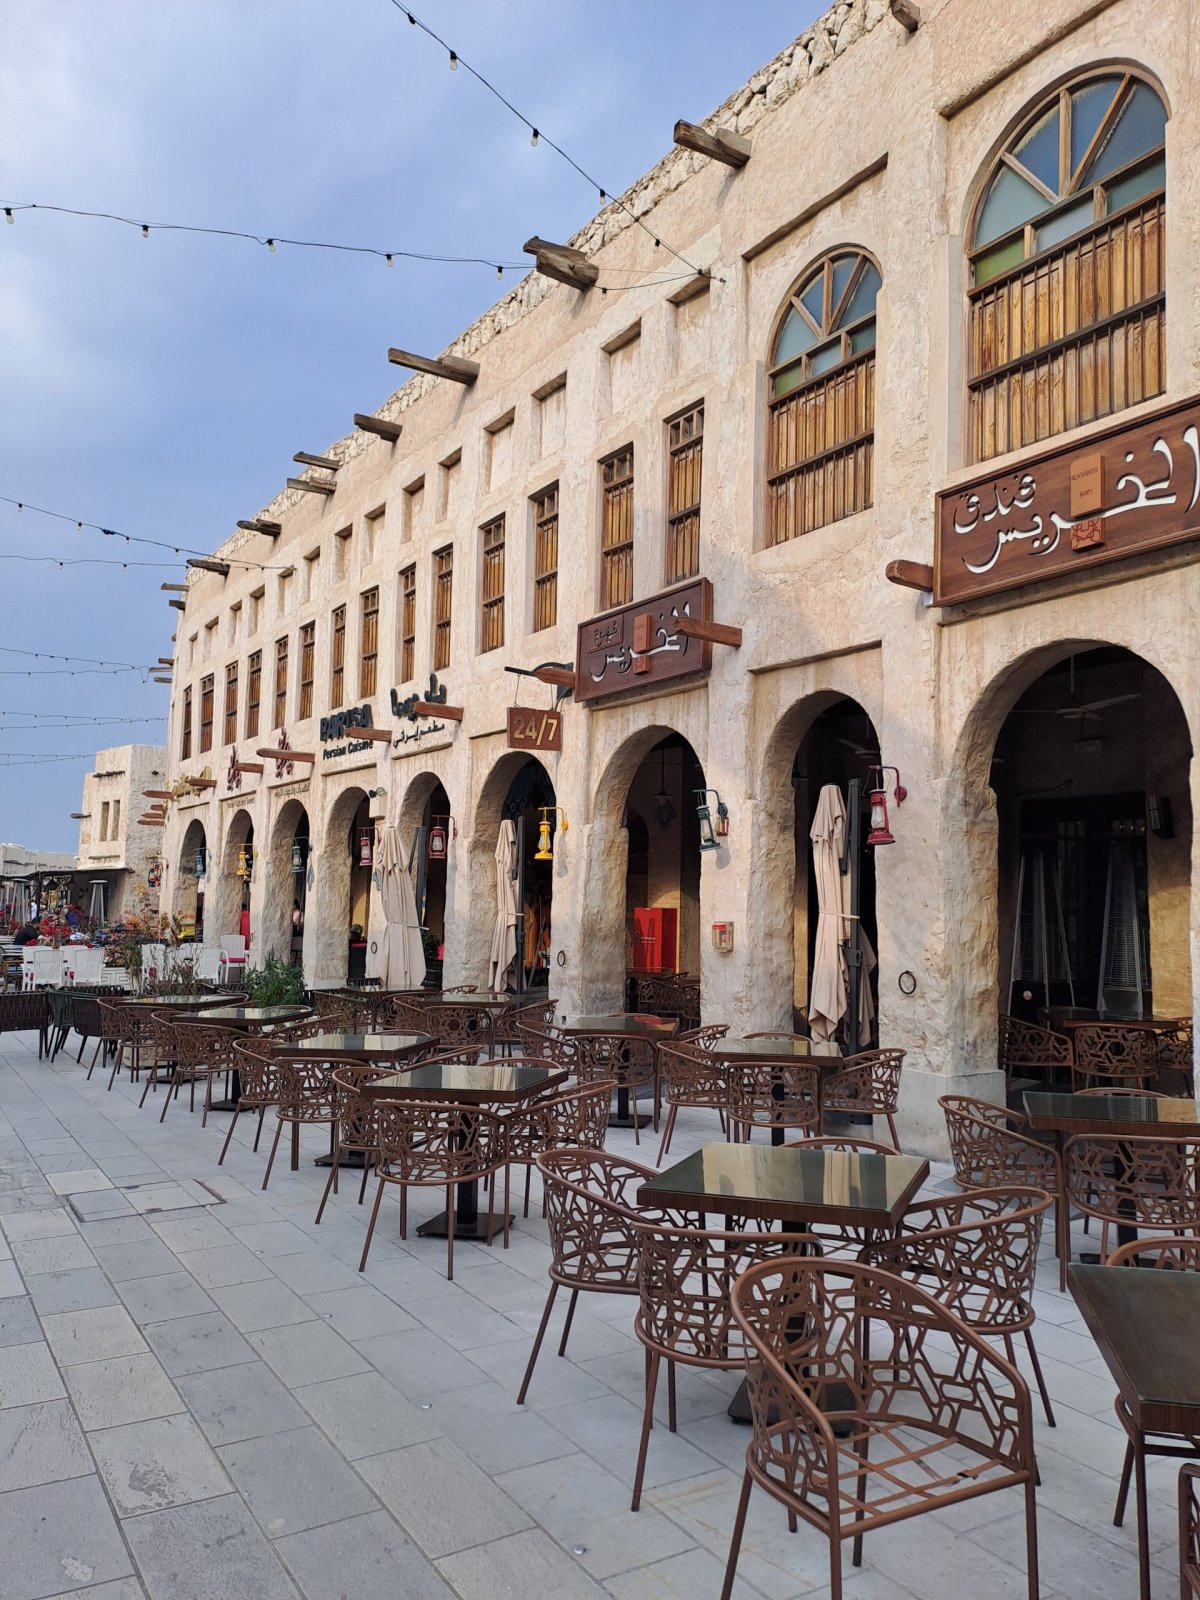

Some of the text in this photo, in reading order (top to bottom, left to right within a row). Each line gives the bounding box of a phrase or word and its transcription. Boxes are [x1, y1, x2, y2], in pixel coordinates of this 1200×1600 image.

[954, 473, 1037, 534] فندق
[320, 704, 374, 743] PARISA
[513, 714, 558, 746] 24/7
[323, 739, 374, 760] Persian Cuisine
